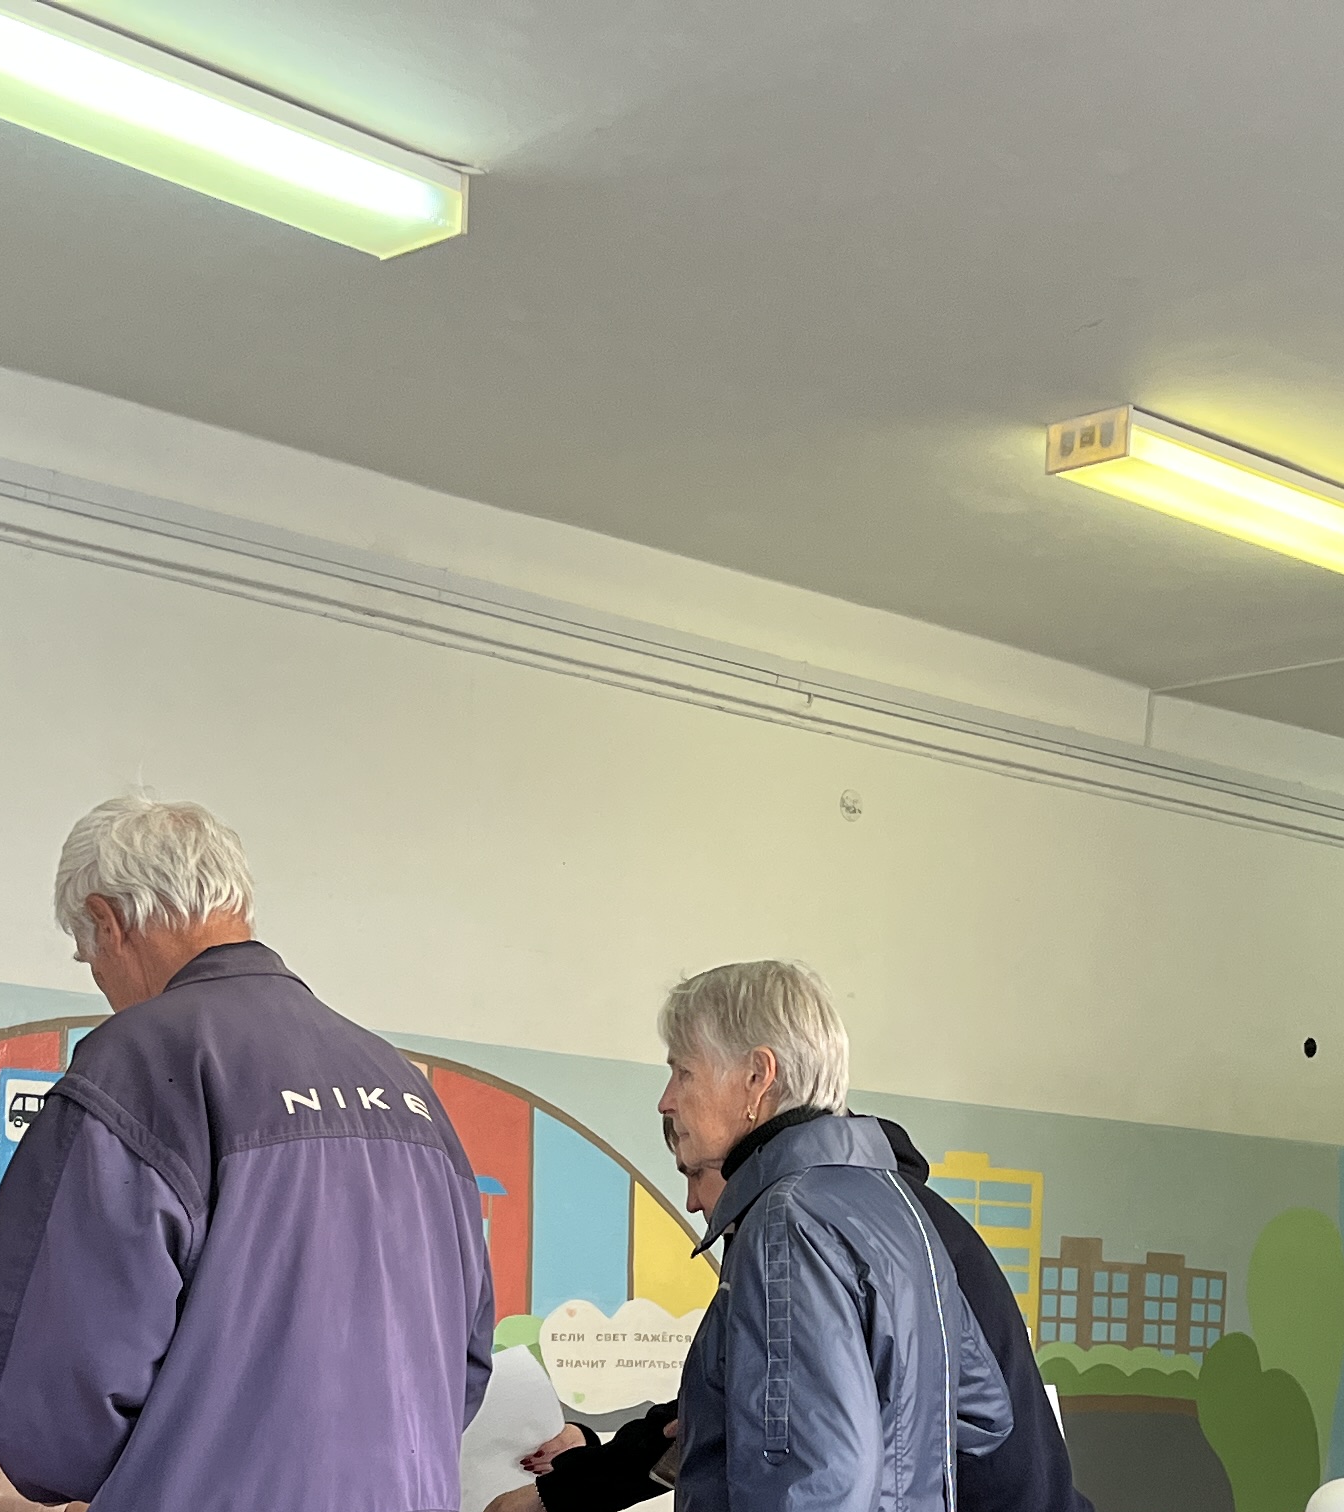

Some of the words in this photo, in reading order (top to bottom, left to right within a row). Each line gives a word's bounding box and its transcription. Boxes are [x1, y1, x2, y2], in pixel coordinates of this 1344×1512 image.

[280, 1086, 433, 1123] NIKE
[551, 1333, 584, 1342] ЕСЛИ
[596, 1333, 628, 1342] СВЕТ
[556, 1358, 606, 1368] ЗНАЧИТ
